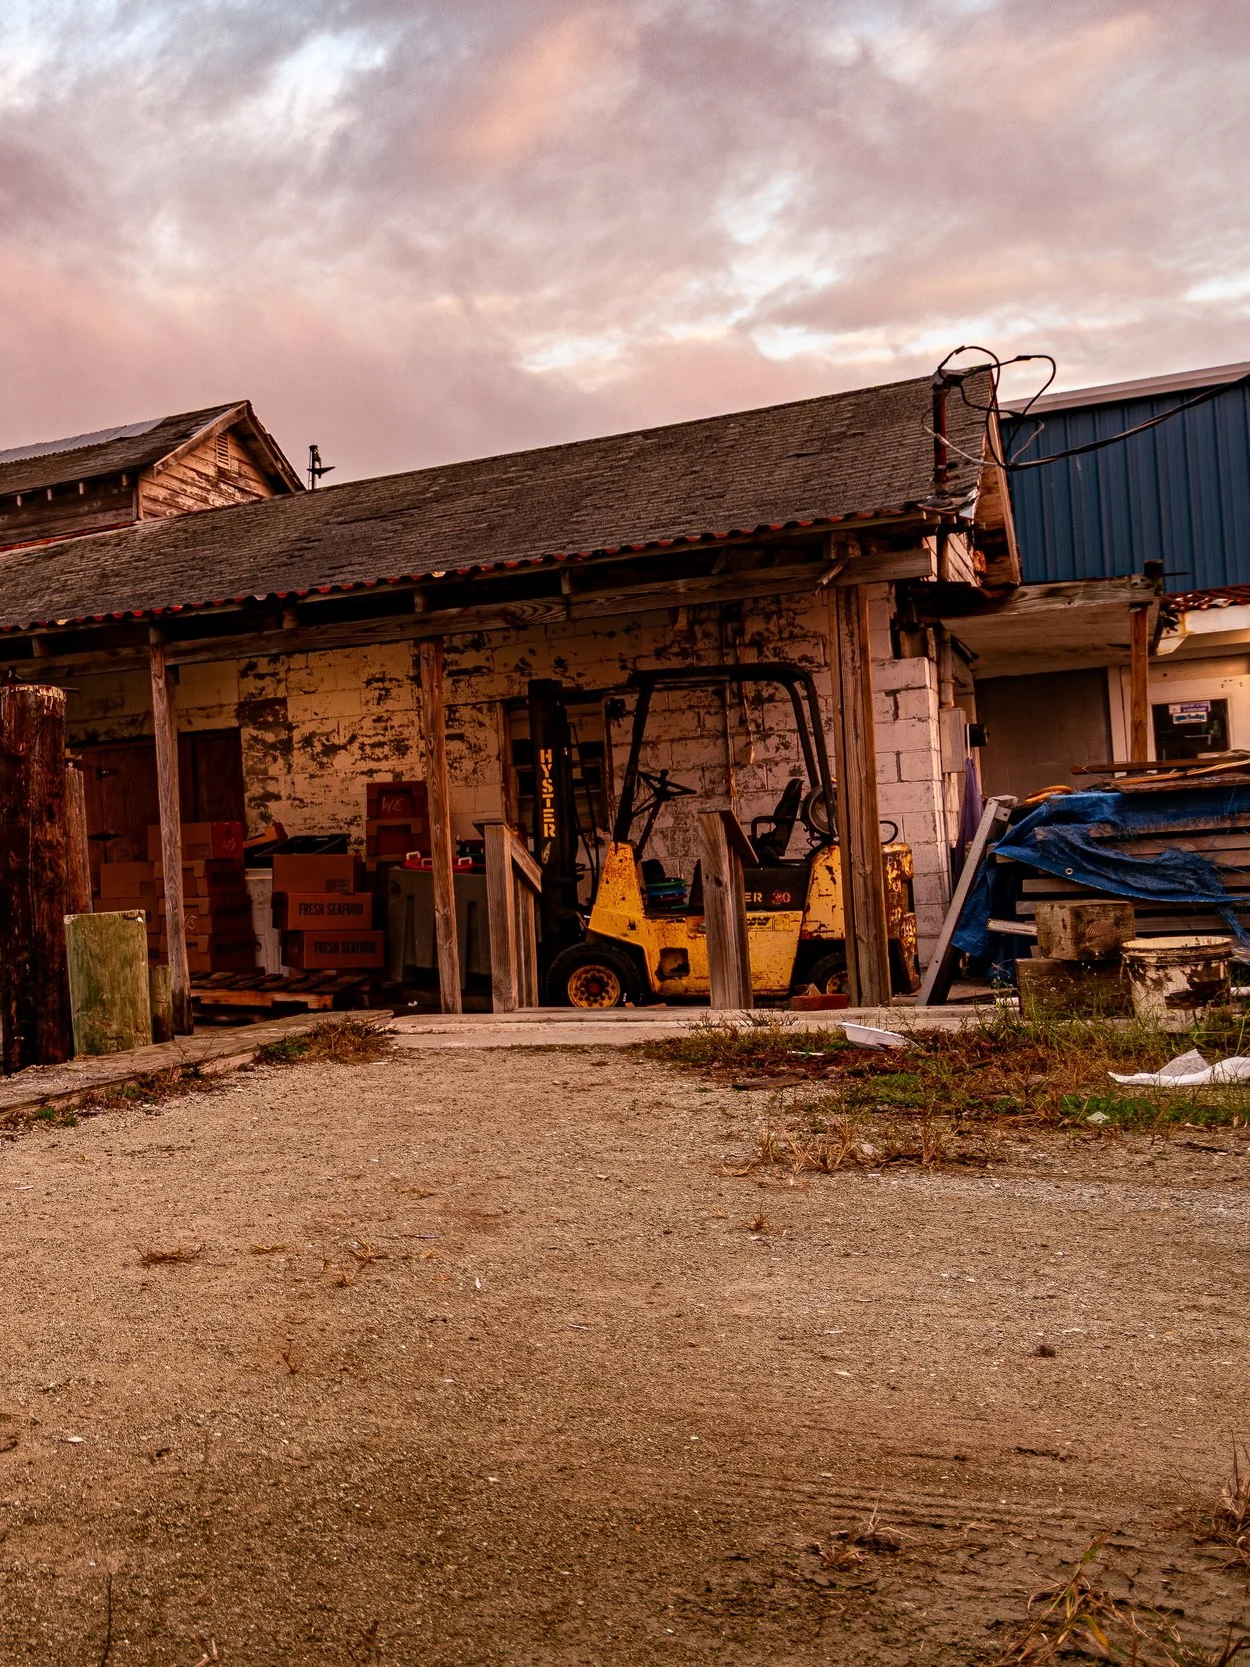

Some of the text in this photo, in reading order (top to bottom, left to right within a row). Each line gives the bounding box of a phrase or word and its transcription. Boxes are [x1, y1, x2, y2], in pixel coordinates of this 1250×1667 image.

[539, 748, 556, 838] HYSTER
[298, 902, 363, 916] FRESH SEAFOOD
[314, 940, 377, 954] FRESH SEAFOOD
